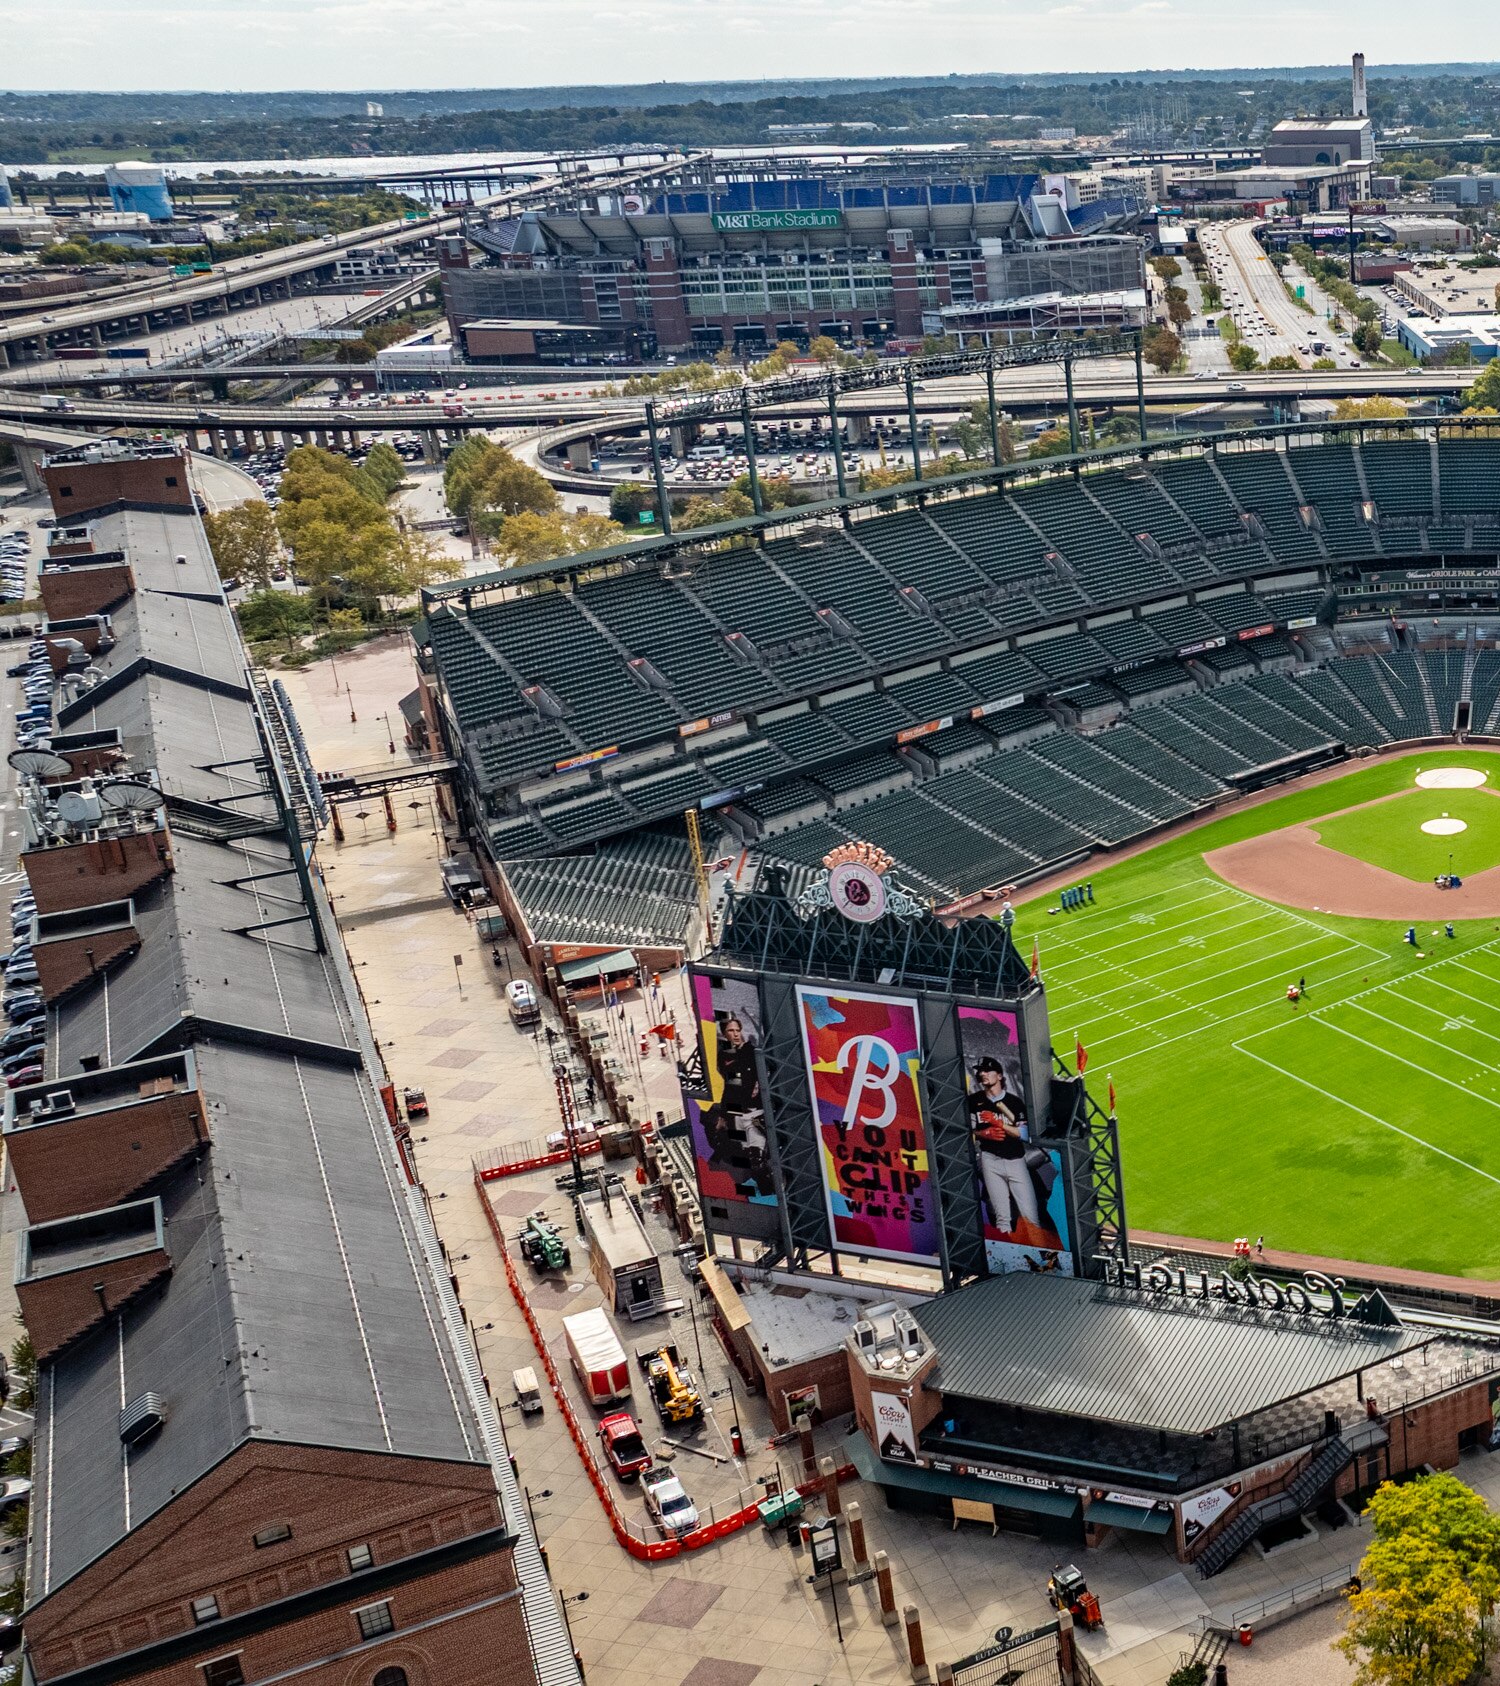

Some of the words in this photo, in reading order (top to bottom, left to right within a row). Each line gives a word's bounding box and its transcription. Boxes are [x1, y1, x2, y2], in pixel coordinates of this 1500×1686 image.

[716, 214, 750, 229] M&T
[751, 213, 783, 228] Bank
[784, 212, 837, 227] Stadium
[1431, 569, 1457, 578] ORIOLE
[1458, 569, 1476, 577] PARK
[1113, 662, 1134, 674] SHIFT
[833, 1119, 916, 1153] YOU
[836, 1144, 918, 1171] CAN'T
[840, 1163, 922, 1196] CLIP
[843, 1187, 925, 1210] THESE
[844, 1199, 926, 1224] WINGS
[878, 1405, 905, 1420] Coors
[882, 1415, 904, 1424] LIGHT
[968, 1466, 1024, 1483] BLEACHER
[1026, 1477, 1060, 1490] GRILL
[1198, 1496, 1220, 1509] Coors
[975, 1644, 1004, 1662] EUTAW
[1005, 1632, 1036, 1649] STREET
